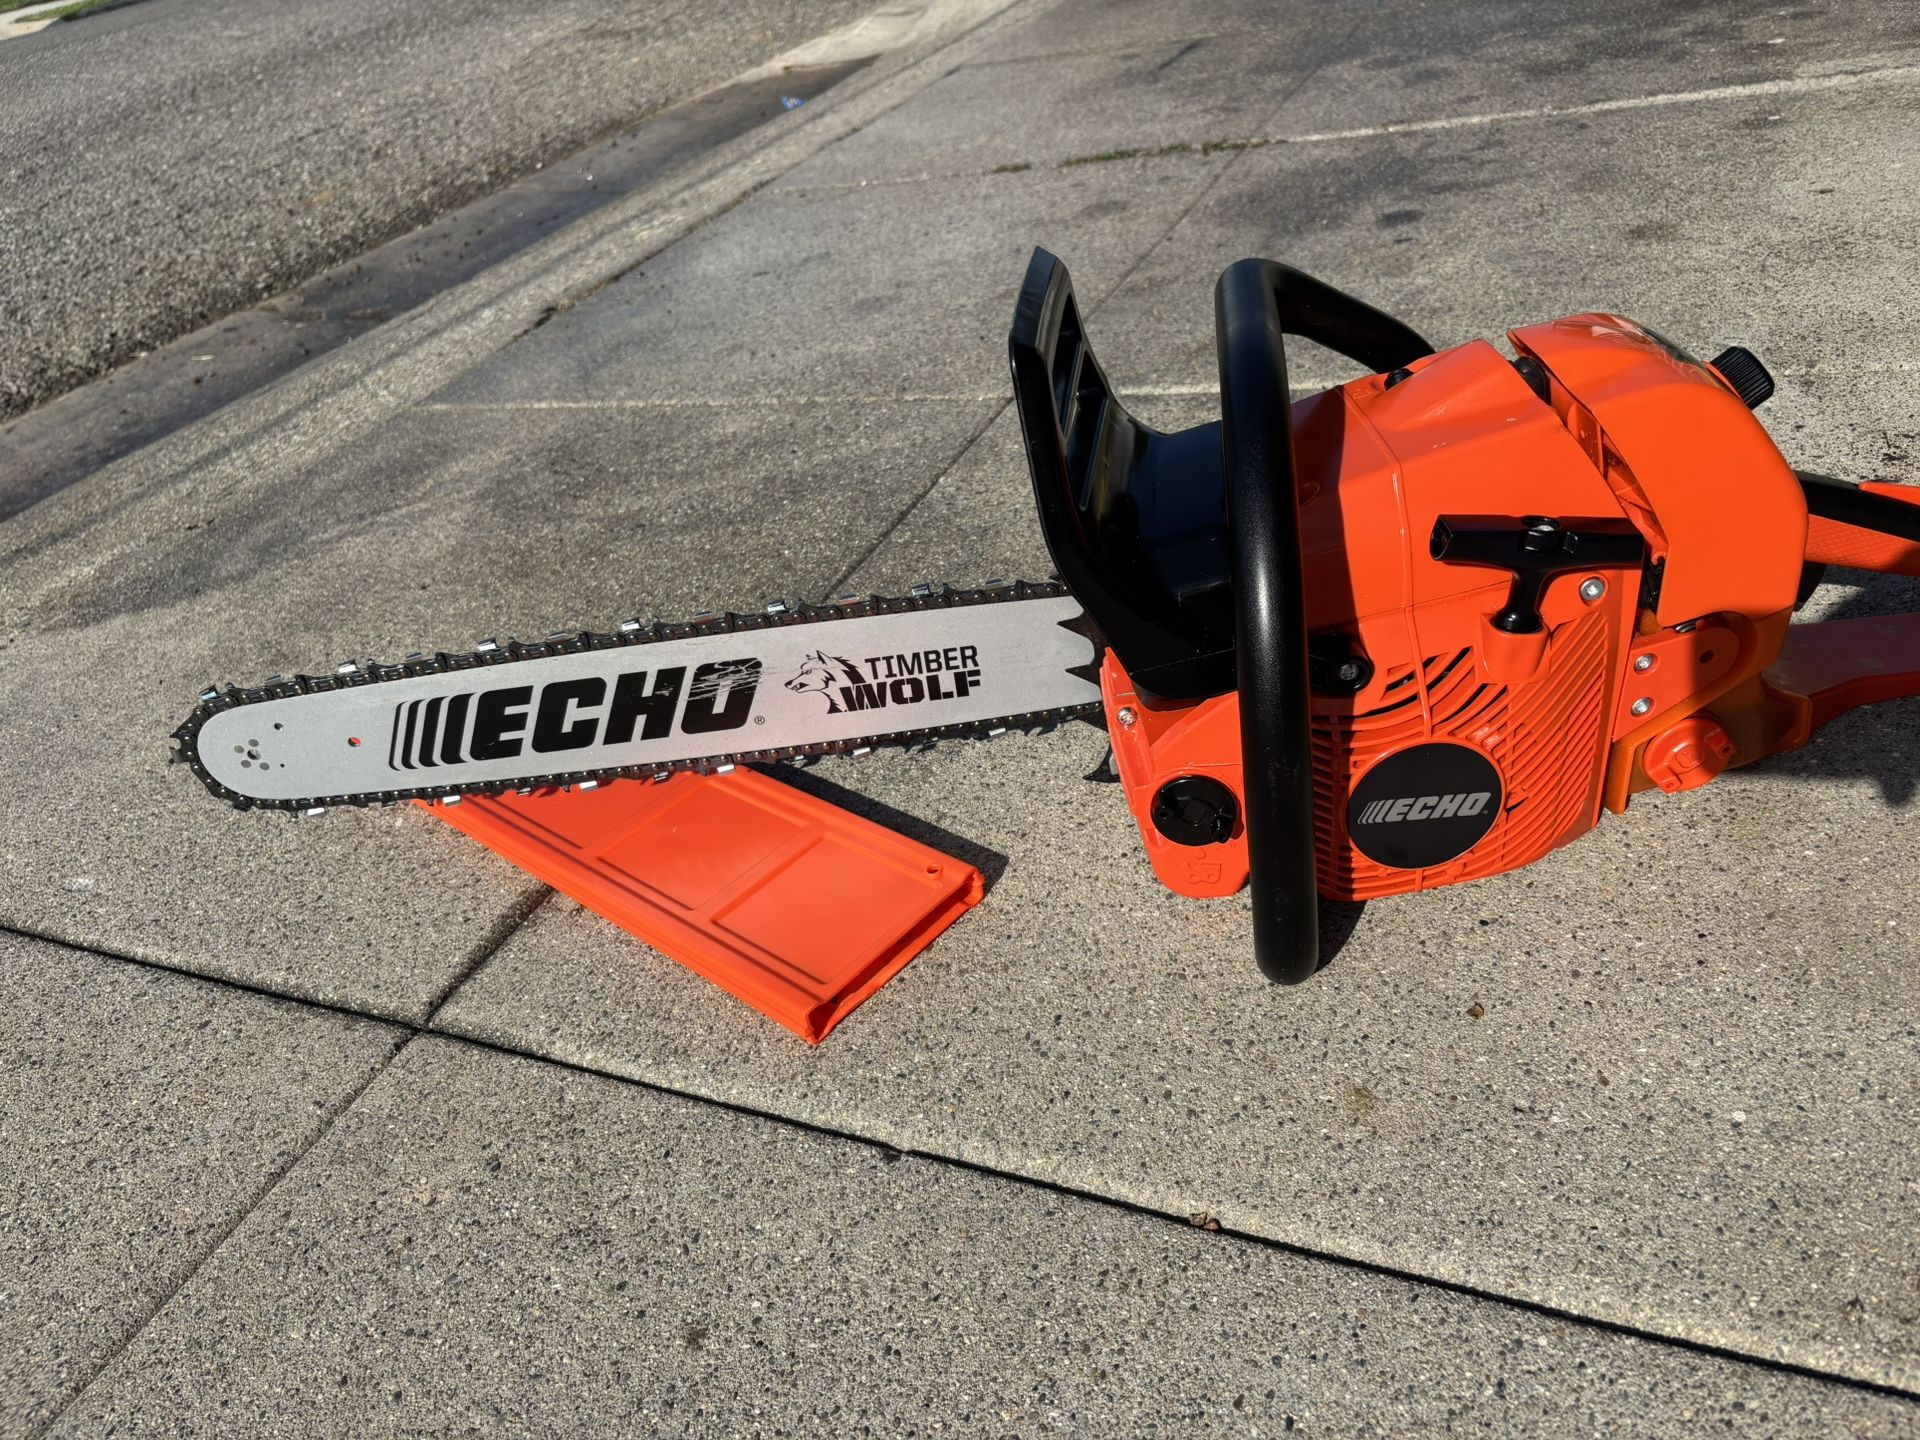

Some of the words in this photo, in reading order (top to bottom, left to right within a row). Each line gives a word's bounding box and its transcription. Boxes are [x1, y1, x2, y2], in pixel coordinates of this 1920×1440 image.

[864, 645, 979, 680] TIMBER
[470, 657, 762, 761] ECHO
[839, 669, 981, 712] WOLF
[1384, 792, 1491, 822] ECHO
